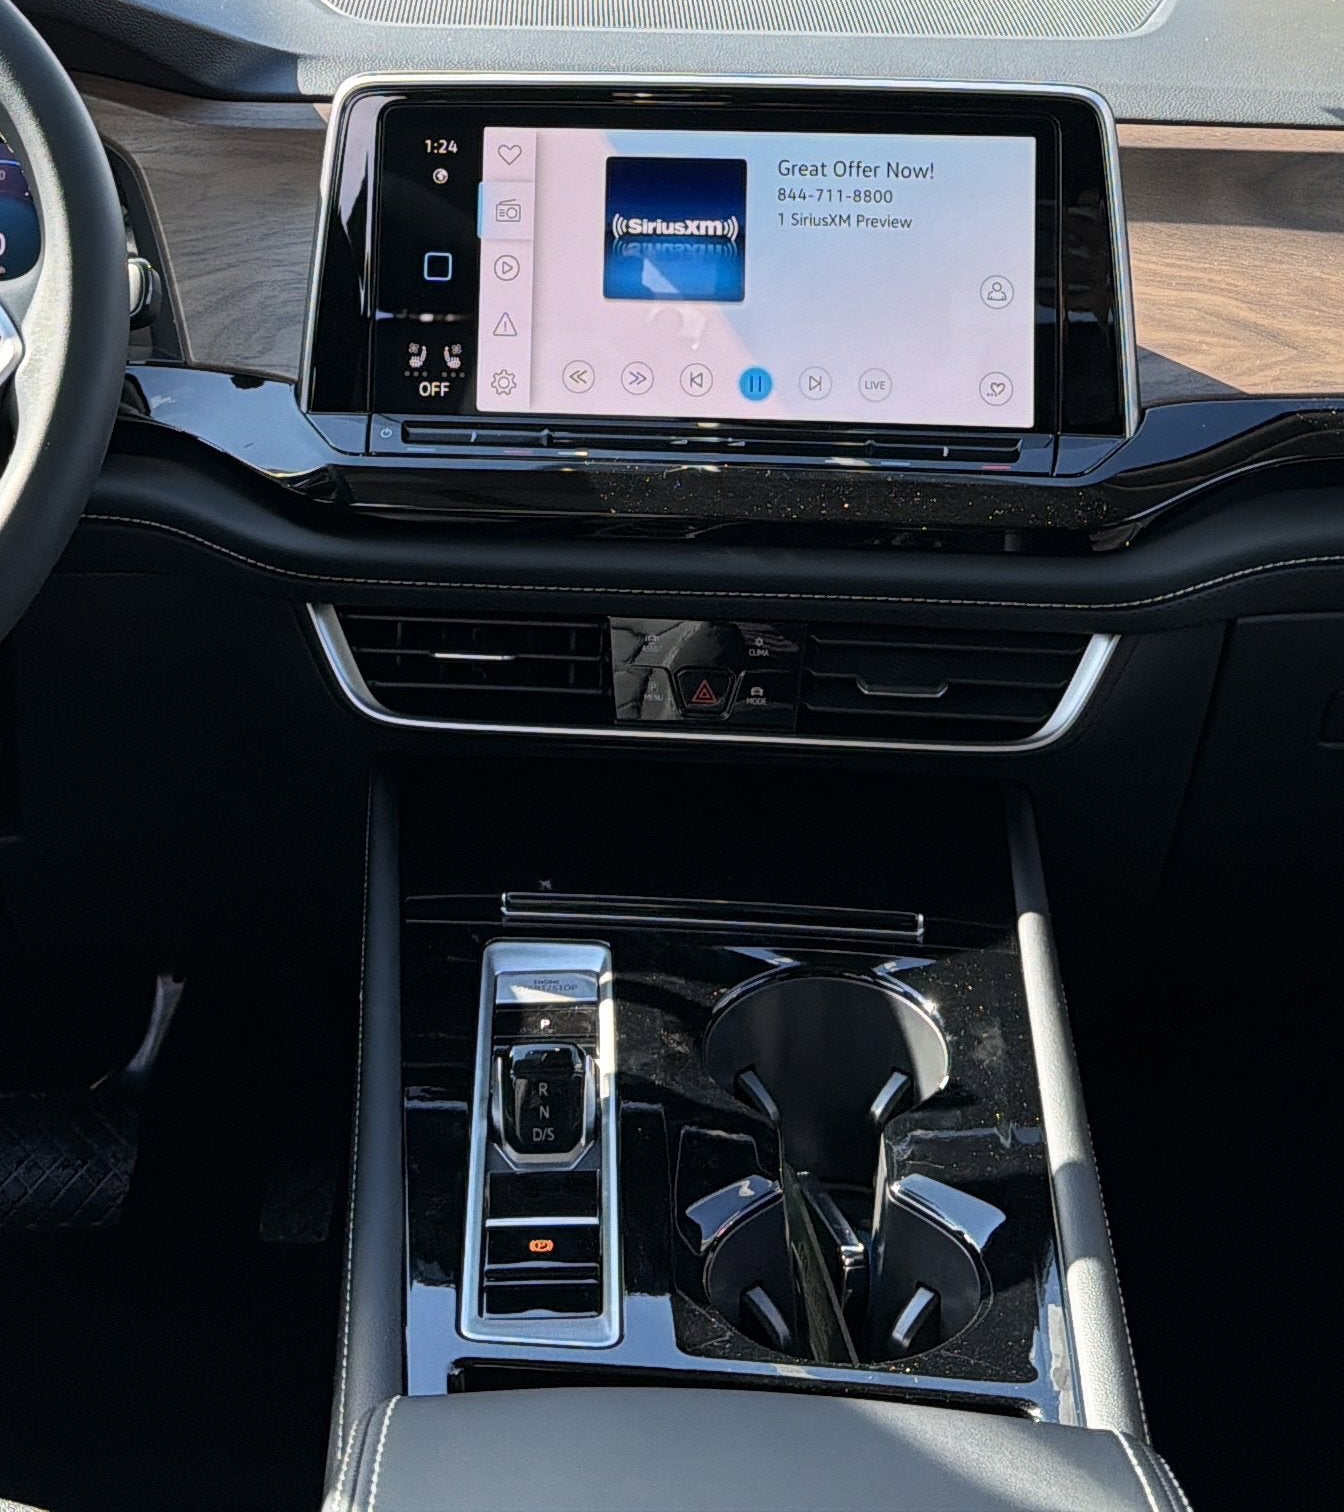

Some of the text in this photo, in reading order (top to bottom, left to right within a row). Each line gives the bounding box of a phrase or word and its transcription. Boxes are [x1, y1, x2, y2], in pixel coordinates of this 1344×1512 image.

[424, 139, 459, 155] 1:24
[777, 159, 935, 180] Great Offer Now!
[777, 188, 894, 205] 844-711-8800
[778, 212, 913, 230] 1 SiriusXM Preview
[418, 381, 451, 397] OFF
[864, 380, 886, 391] LIVE
[748, 648, 771, 658] CLIMA
[745, 697, 768, 705] MODE
[540, 1018, 551, 1030] P
[538, 1082, 549, 1097] R
[539, 1105, 550, 1120] N
[532, 1127, 555, 1142] D/S
